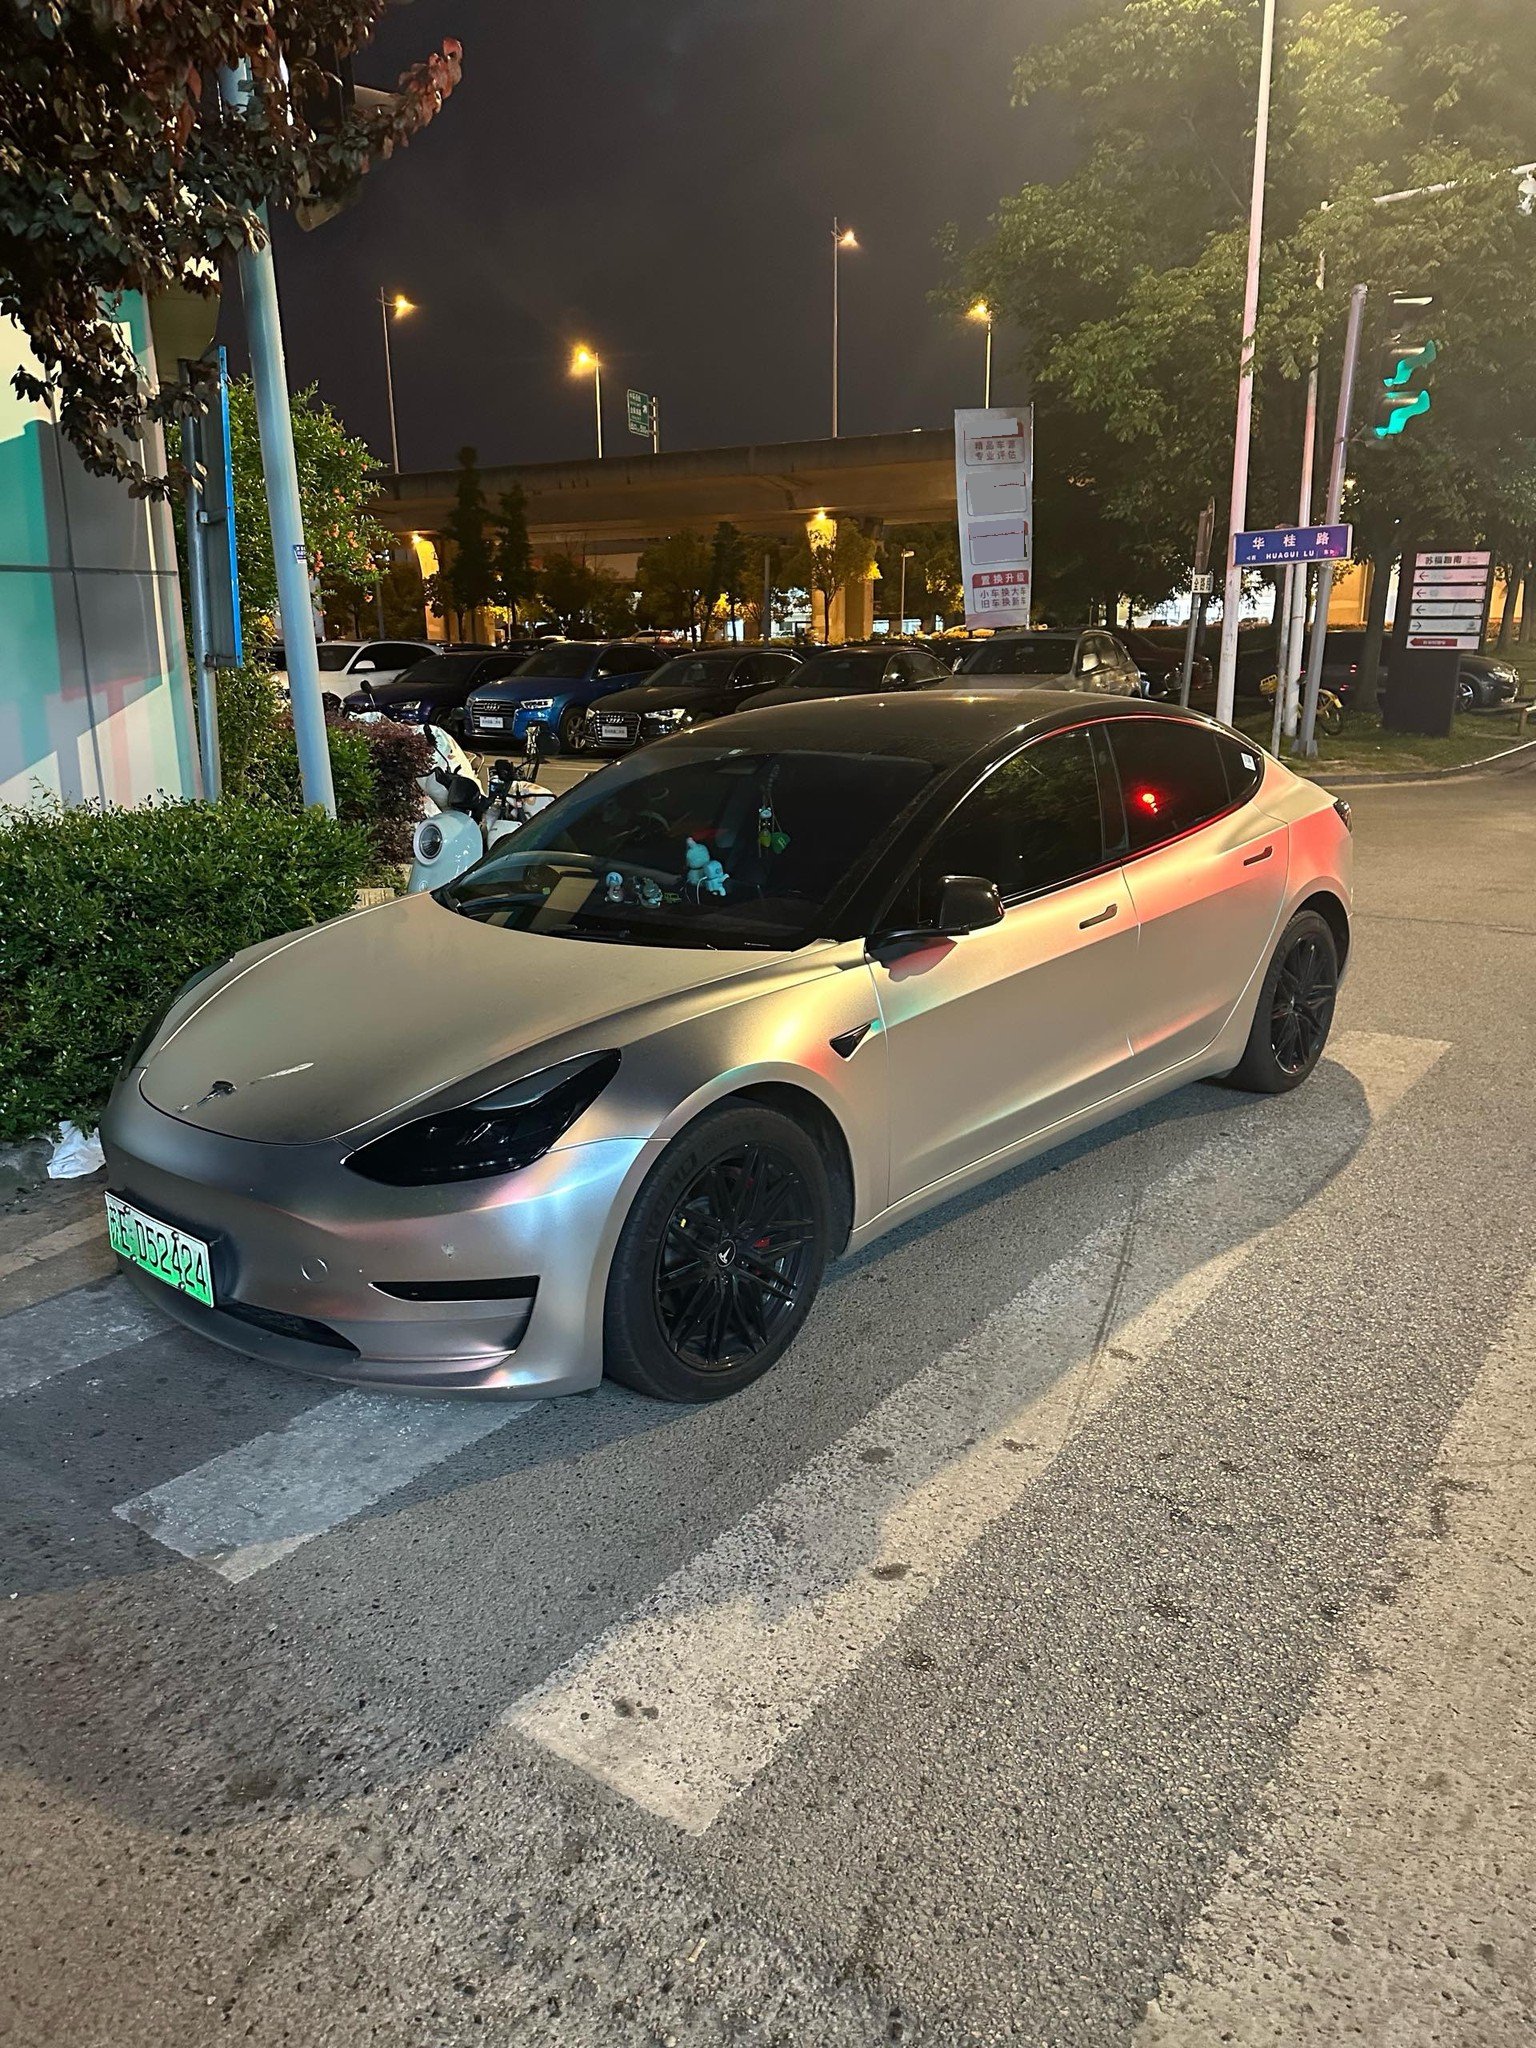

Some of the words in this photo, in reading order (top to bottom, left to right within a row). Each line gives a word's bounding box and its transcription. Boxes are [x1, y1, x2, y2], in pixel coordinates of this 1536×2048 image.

[974, 450, 1017, 460] 专业评估
[1252, 531, 1330, 550] 华桂路
[1266, 550, 1299, 560] HUAGUI
[1303, 549, 1315, 557] LU
[981, 572, 1025, 586] 置换升级
[980, 587, 1026, 599] 小车换大车
[981, 597, 1026, 609] 旧车换新车
